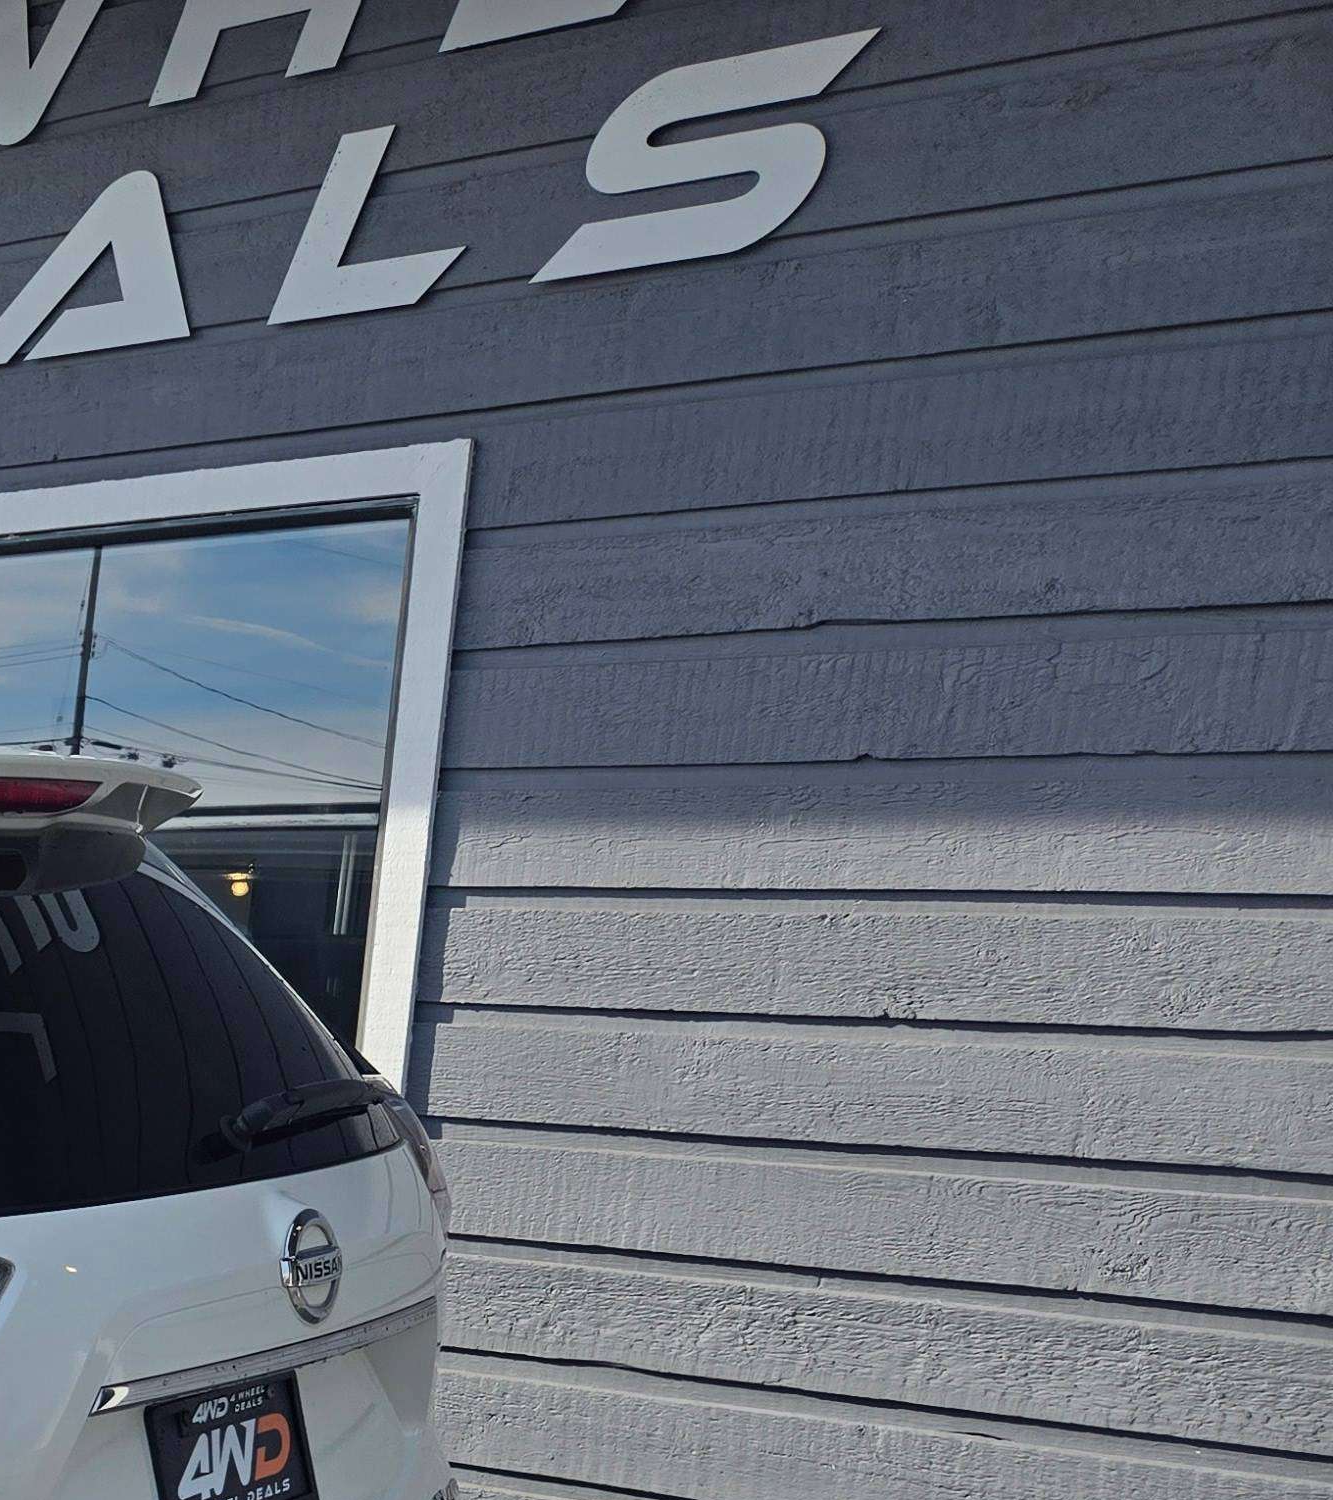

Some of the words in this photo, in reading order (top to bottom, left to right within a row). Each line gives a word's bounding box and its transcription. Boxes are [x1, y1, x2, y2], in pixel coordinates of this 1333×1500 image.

[295, 1254, 342, 1281] NISSAN
[192, 1396, 229, 1424] 4WD
[238, 1385, 265, 1401] WHEEL
[234, 1396, 263, 1412] DEALS
[178, 1413, 290, 1500] 4WD
